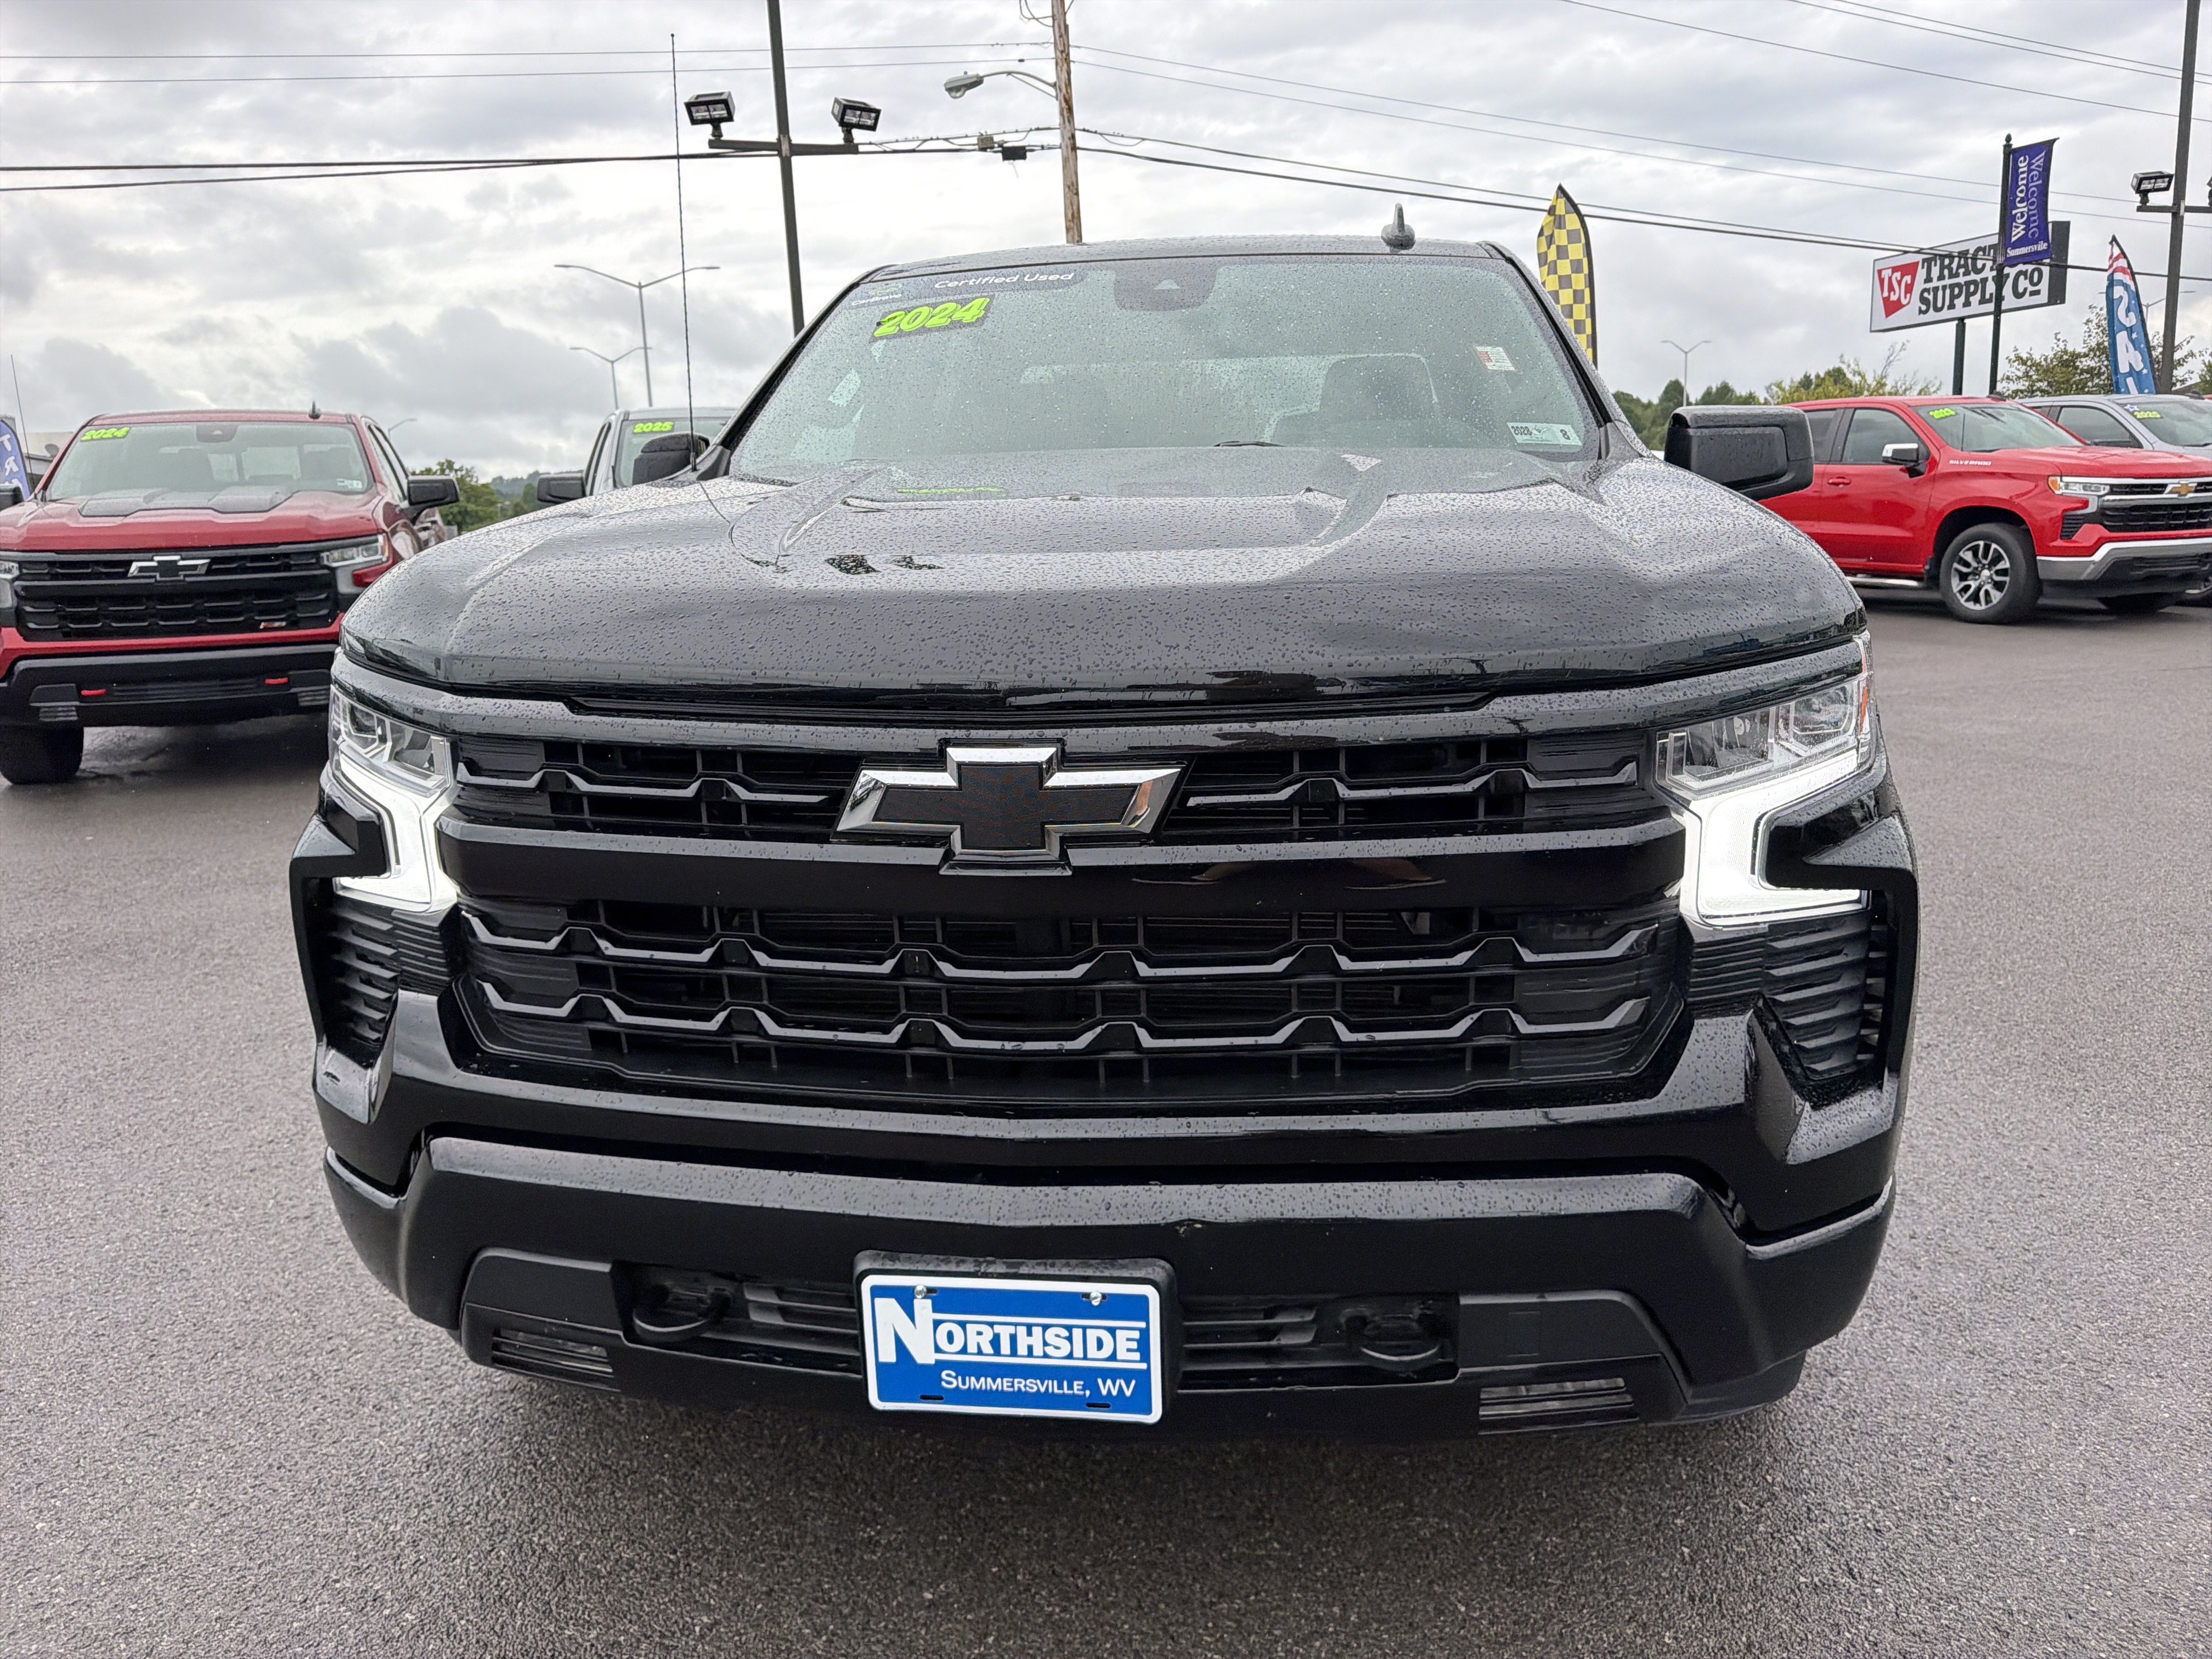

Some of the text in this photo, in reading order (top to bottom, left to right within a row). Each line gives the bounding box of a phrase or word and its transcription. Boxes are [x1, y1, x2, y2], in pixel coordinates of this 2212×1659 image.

[2011, 154, 2029, 243] Welcome
[2028, 150, 2046, 239] Welcome
[934, 273, 1075, 289] Certified Used
[1881, 268, 1911, 305] TSC
[873, 297, 990, 337] 2024
[633, 421, 674, 433] 2025
[1559, 429, 1571, 441] 8
[874, 1297, 1141, 1365] NORTHSIDE
[940, 1369, 1136, 1397] SUMMERSVILLE, WV
